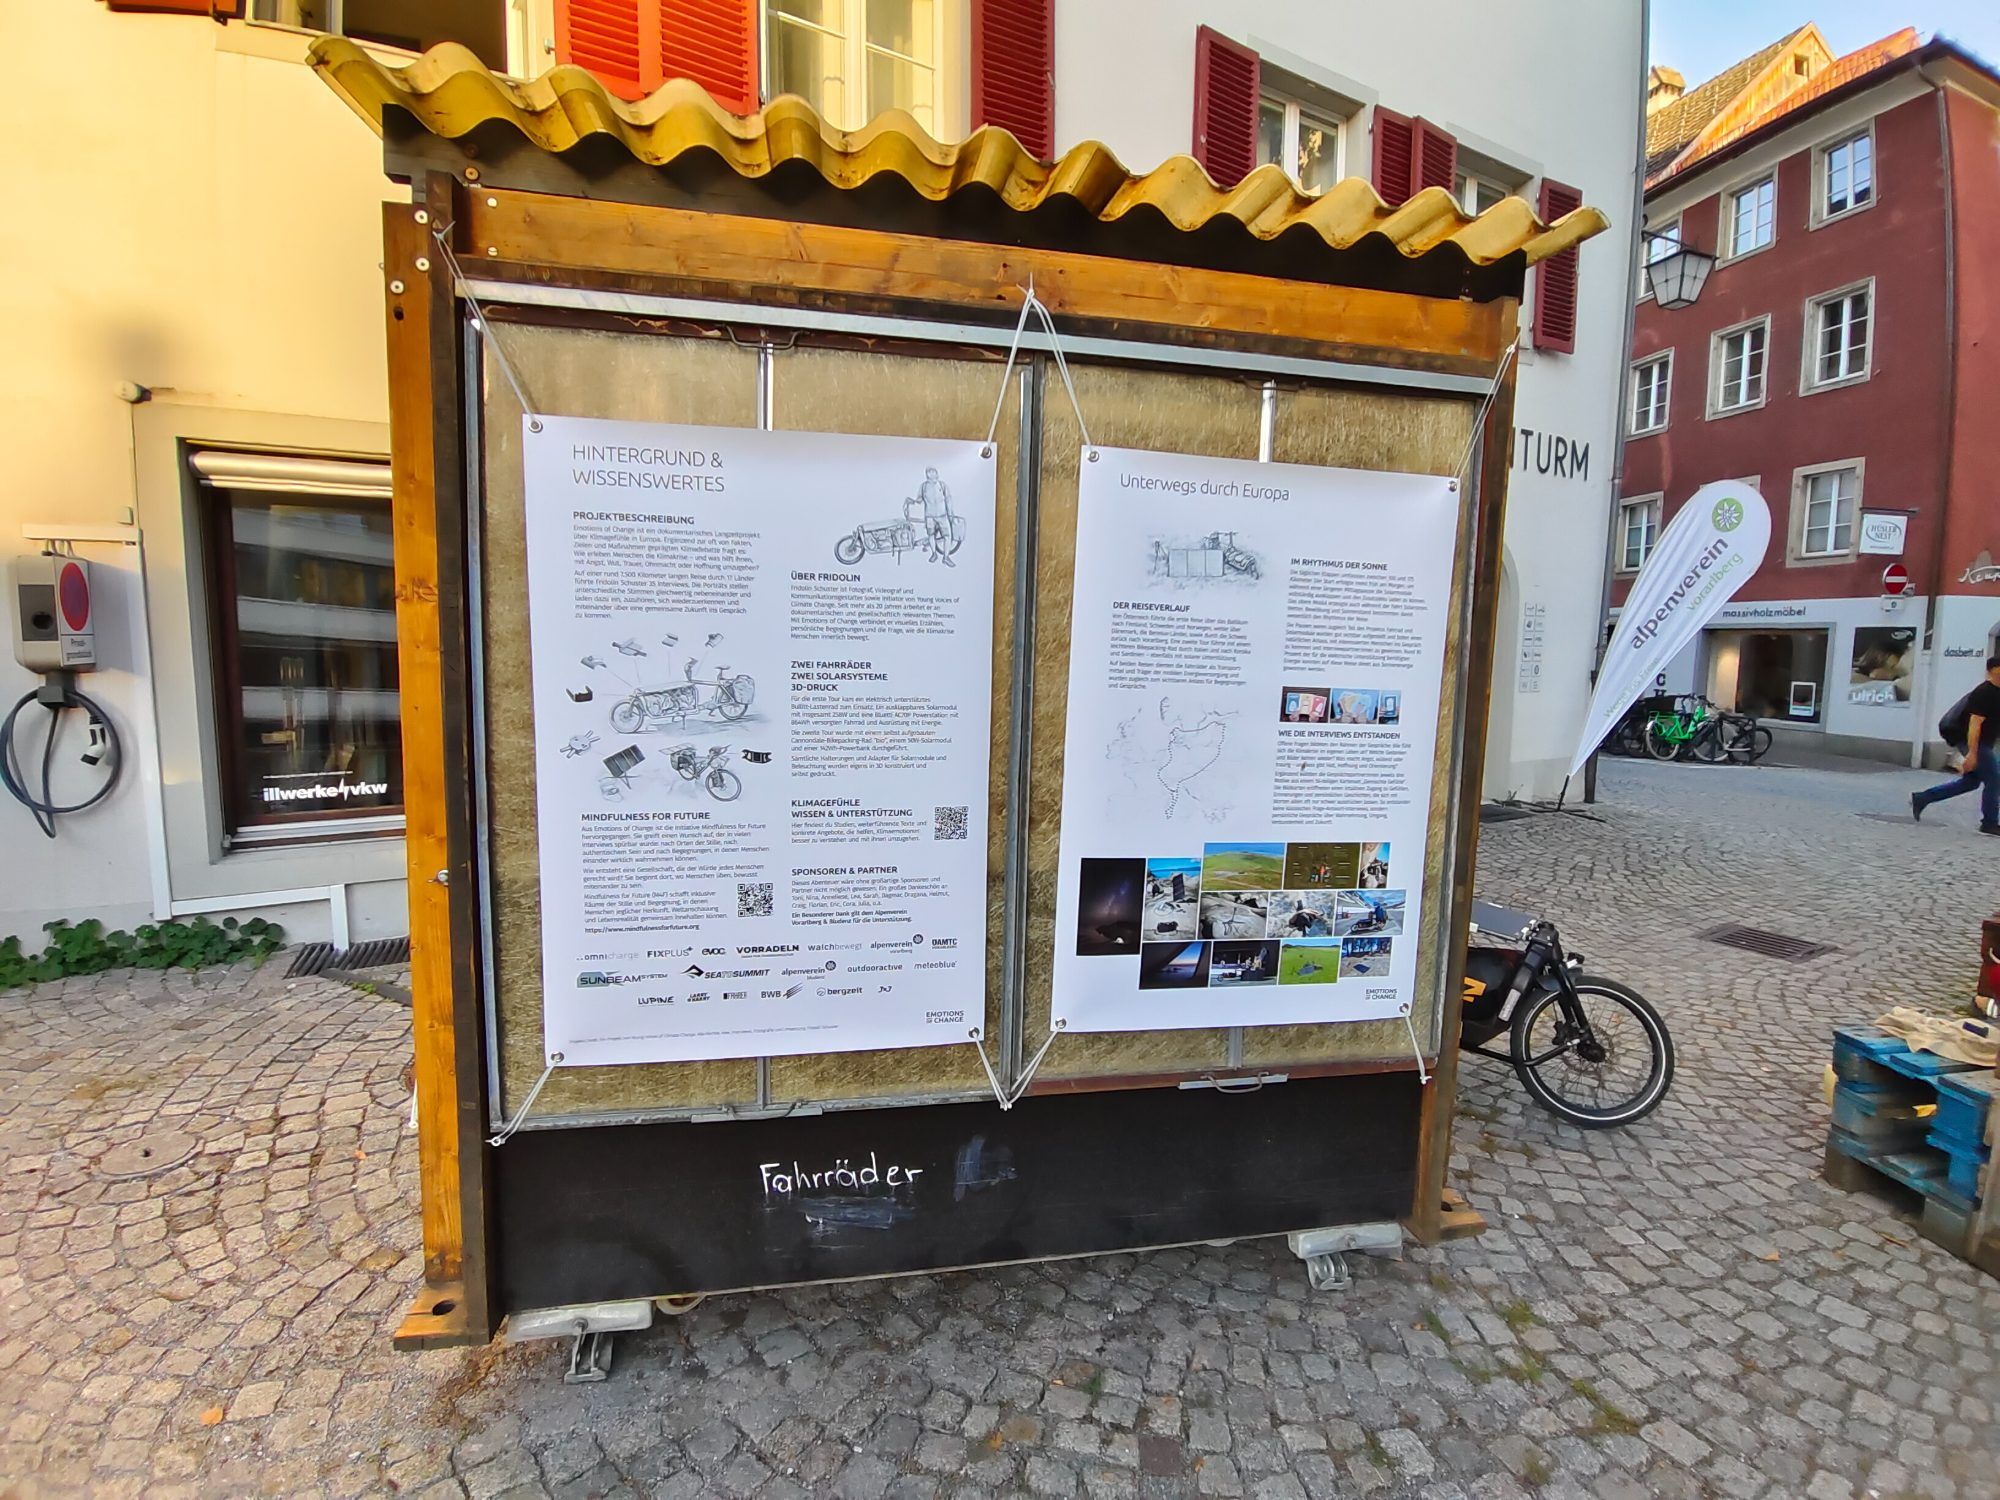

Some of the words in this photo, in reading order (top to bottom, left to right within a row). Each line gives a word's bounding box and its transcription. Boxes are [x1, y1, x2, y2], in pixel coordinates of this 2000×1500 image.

[572, 444, 705, 467] HINTERGRUND
[710, 452, 724, 468] &
[1511, 427, 1589, 482] TURM
[572, 469, 725, 492] WISSENSWERTES
[1120, 473, 1196, 496] Unterwegs
[1200, 480, 1238, 496] durch
[1243, 484, 1290, 502] Europa
[573, 511, 694, 524] PROJEKTBESCHREIBUNG
[1302, 558, 1343, 568] RHYTHMUS
[1361, 562, 1388, 570] SONNE
[791, 570, 815, 580] ÜBER
[818, 573, 861, 582] FRIDOLIN
[1688, 553, 1744, 611] vorarlberg
[1630, 538, 1729, 650] alpenverein
[1131, 603, 1190, 612] REISEVERLAUF
[816, 659, 872, 669] FAHRRÄDER
[816, 672, 888, 680] SOLARSYSTEME
[1852, 688, 1894, 702] ulrich
[263, 784, 338, 802] illwerke
[350, 782, 388, 796] vkw
[792, 797, 860, 807] KLIMAGEFÜHLE
[581, 813, 649, 821] MINDFULNESS
[836, 808, 912, 817] UNTERSTÜTZUNG
[792, 867, 846, 876] SPONSOREN
[857, 866, 898, 874] PARTNER
[736, 944, 800, 954] VORRADELN
[870, 941, 912, 950] alpenverein
[848, 964, 902, 972] outdooractive
[914, 961, 956, 969] meteoblue
[781, 968, 825, 976] alpenverein
[580, 975, 641, 985] SUNBEAM
[827, 987, 862, 996] bergzeit
[638, 996, 674, 1004] LUPINE
[760, 1152, 924, 1194] Fahrräder
